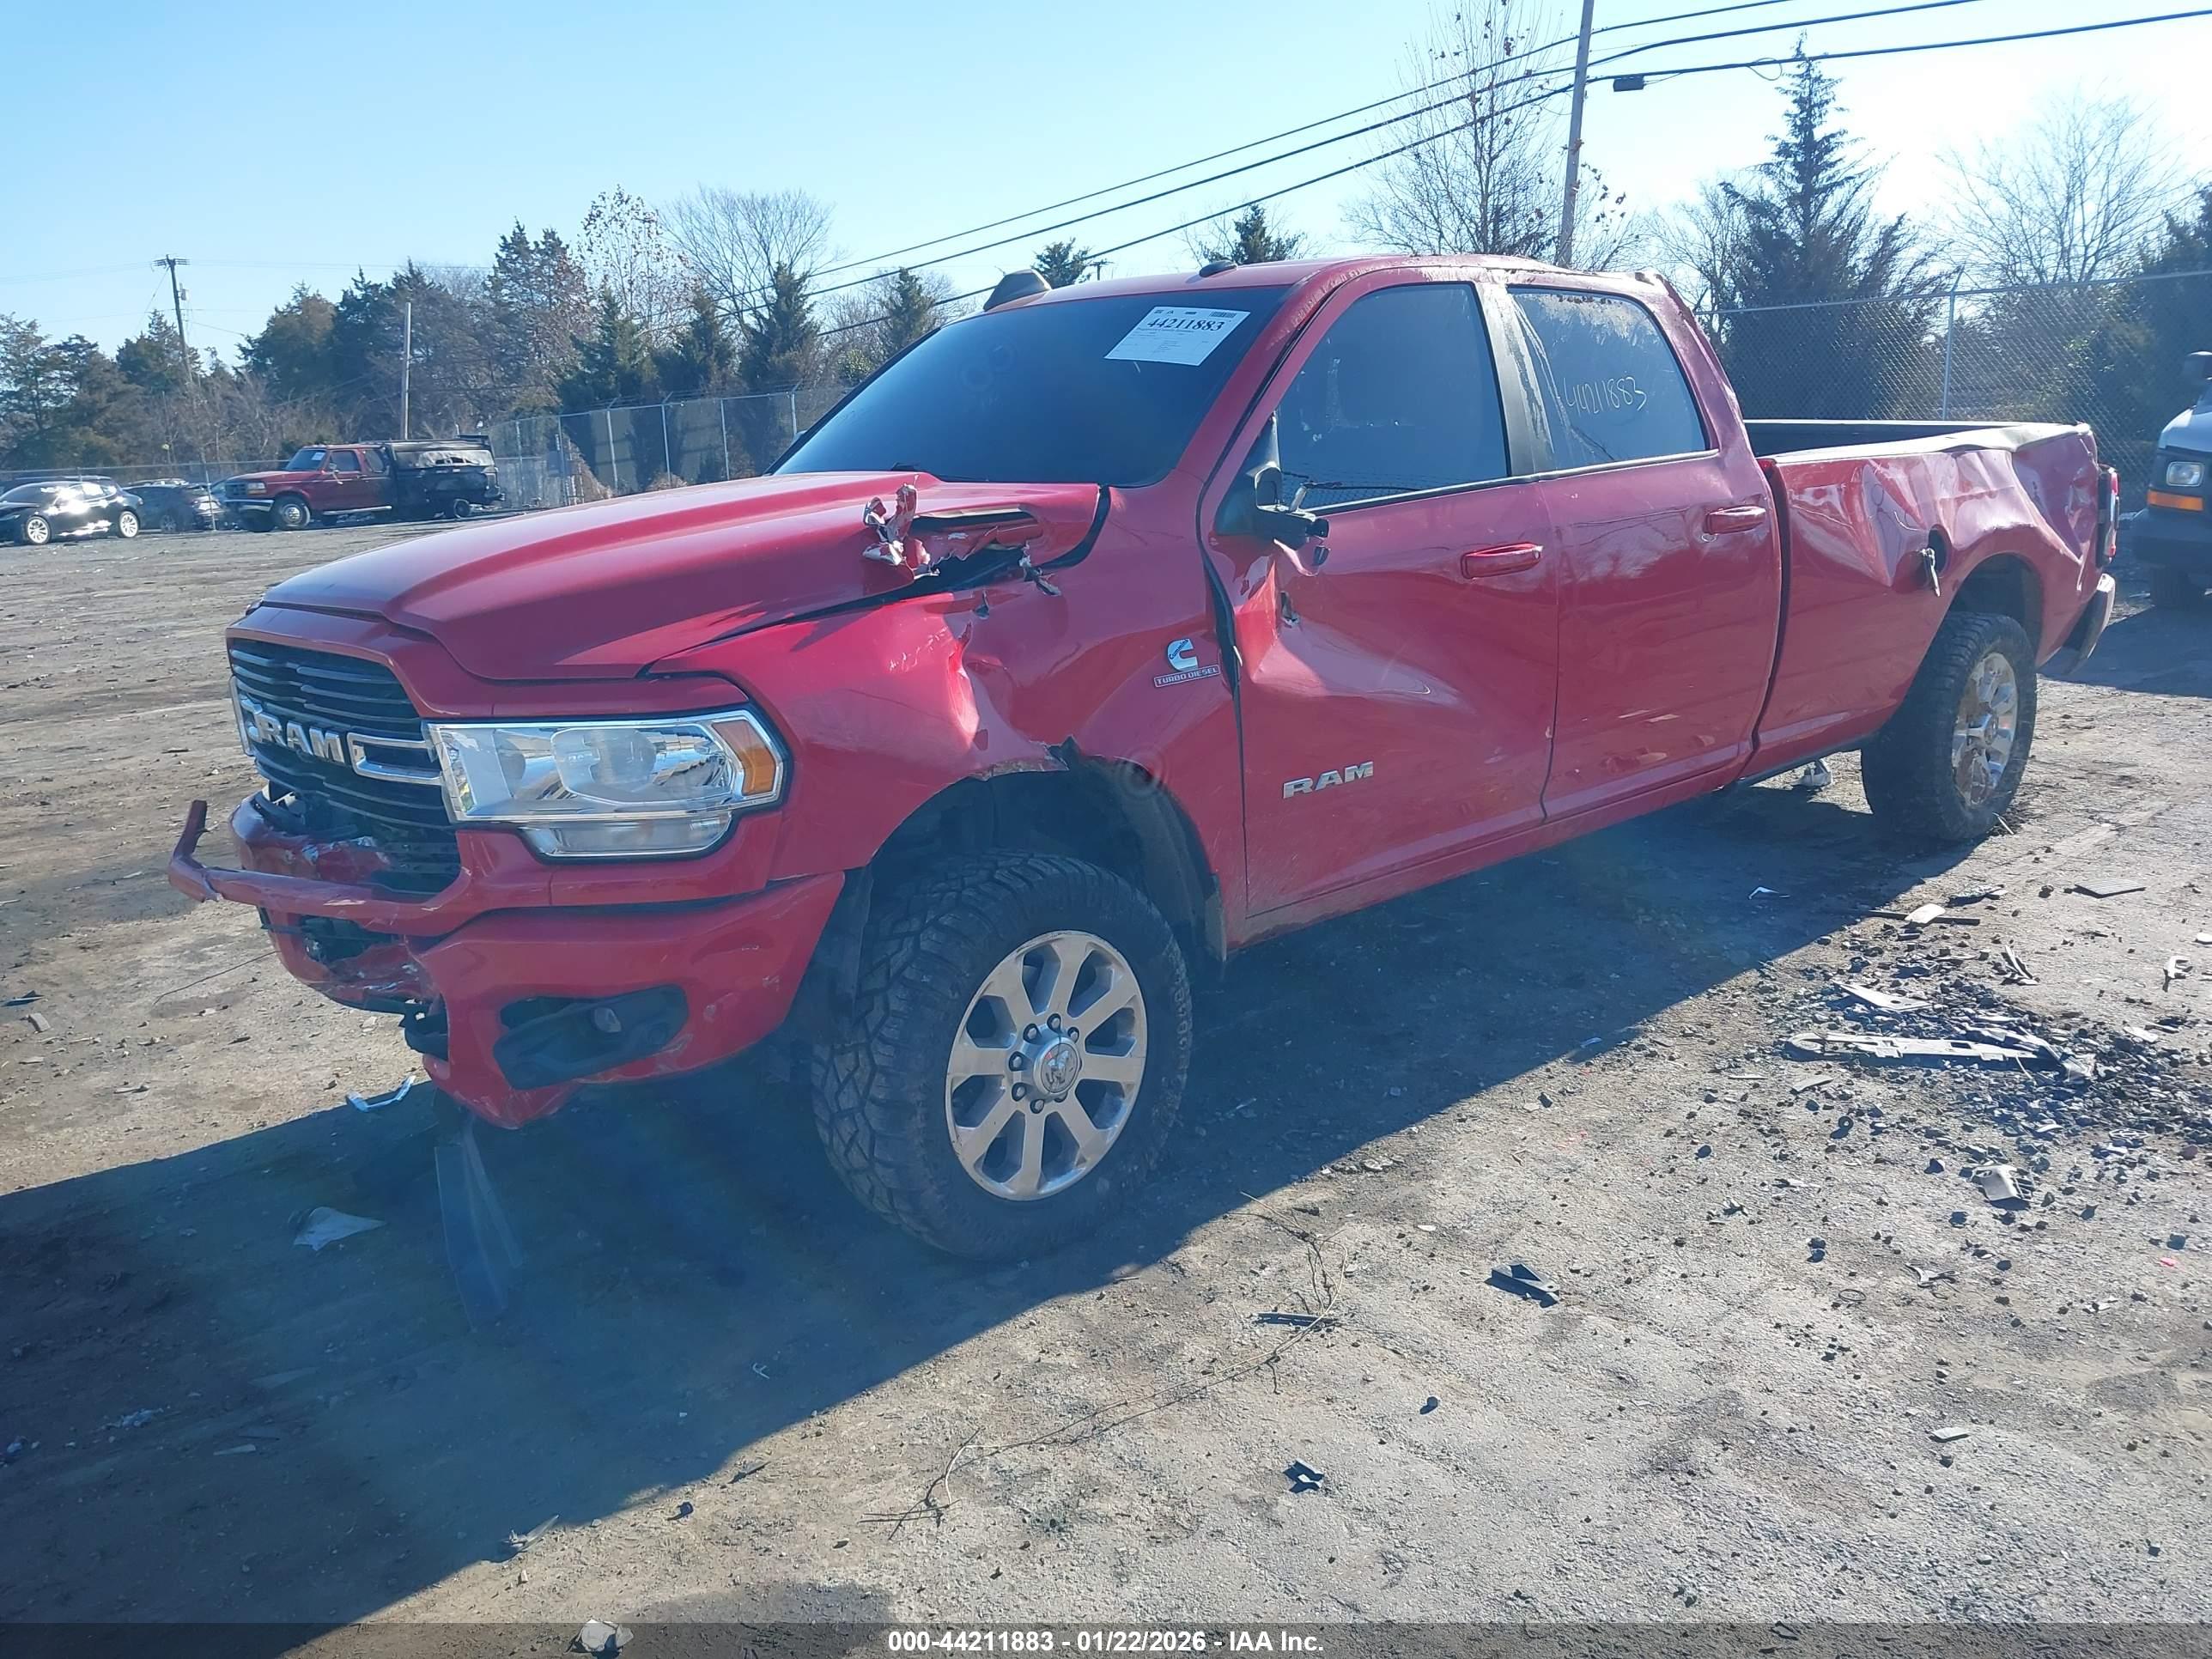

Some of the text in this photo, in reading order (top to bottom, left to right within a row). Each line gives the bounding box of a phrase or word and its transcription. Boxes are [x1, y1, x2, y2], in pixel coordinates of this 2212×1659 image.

[1146, 318, 1225, 331] 44211883
[1563, 376, 1648, 417] 44211883
[1156, 667, 1218, 685] TURBO DIESEL
[255, 712, 345, 763] RAM
[1283, 761, 1374, 799] RAM
